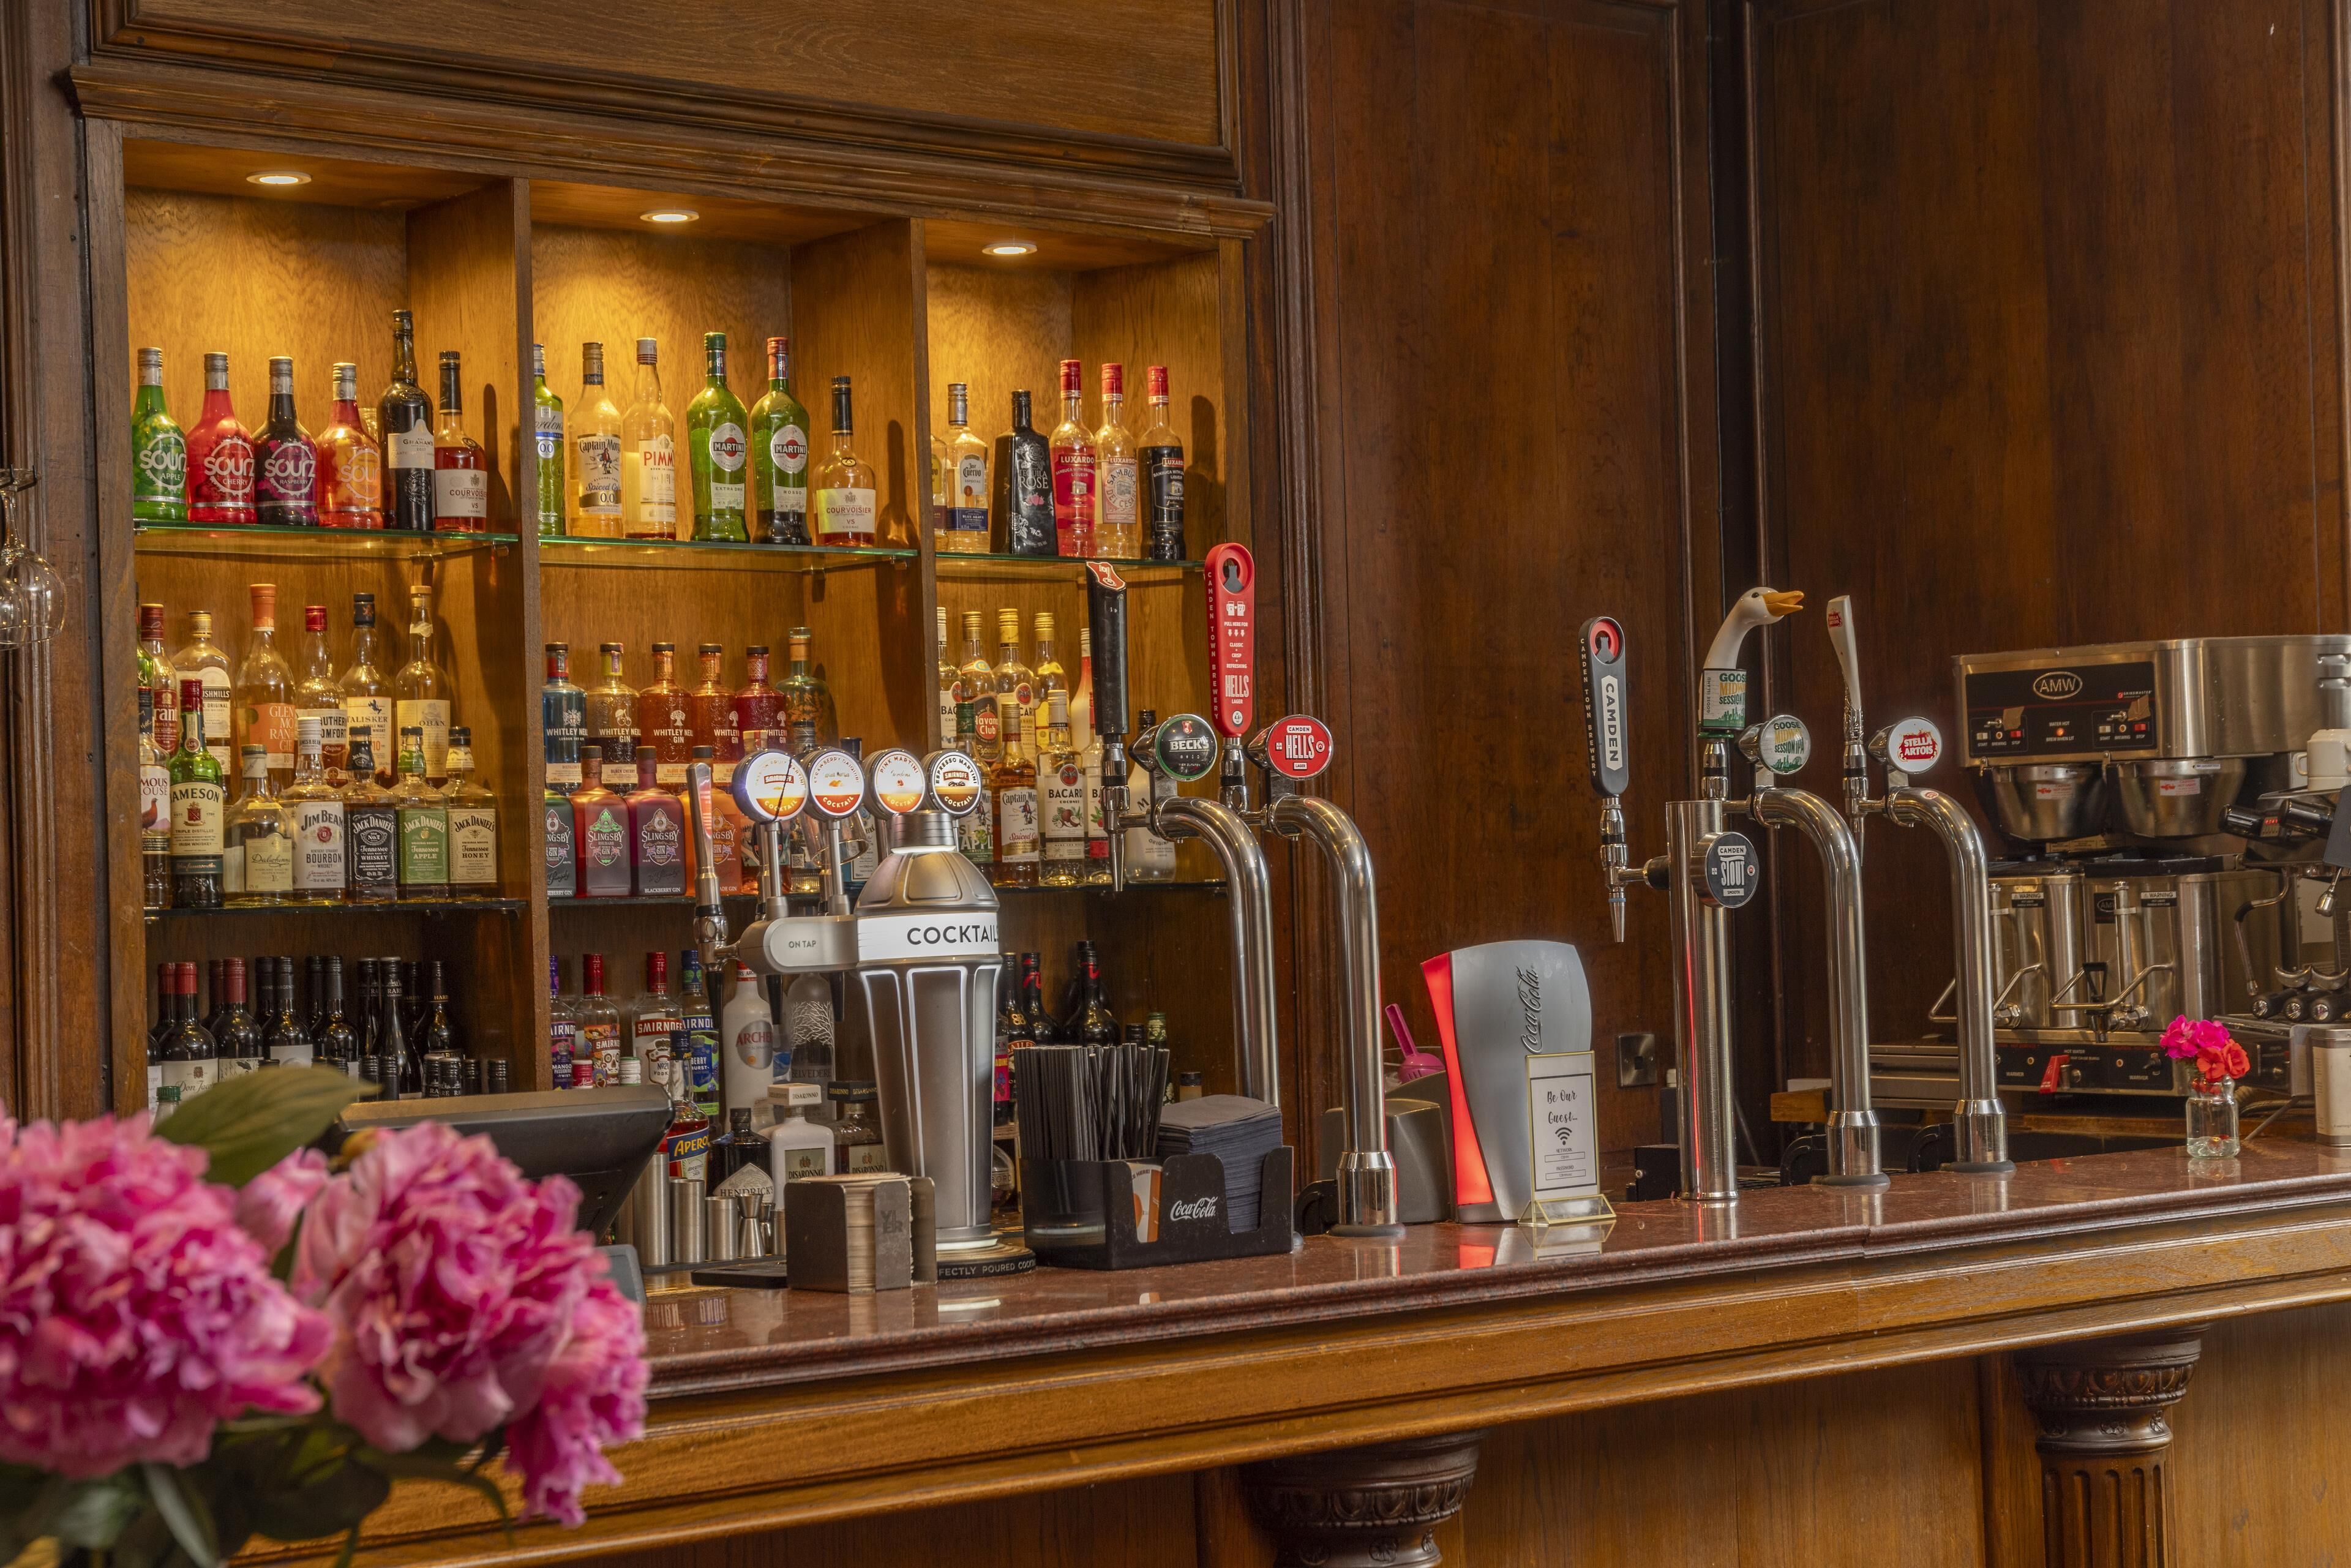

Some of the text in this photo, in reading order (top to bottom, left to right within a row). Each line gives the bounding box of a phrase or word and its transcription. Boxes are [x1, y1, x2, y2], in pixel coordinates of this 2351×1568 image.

[579, 439, 606, 452] Captain
[714, 442, 744, 452] MARTINI
[775, 445, 806, 454] MARTINI
[1060, 456, 1094, 464] LUXARDO
[962, 467, 981, 478] Cuervo
[1019, 477, 1049, 490] ROSE
[1225, 675, 1250, 698] HELLS
[2039, 678, 2076, 693] AMW
[269, 705, 294, 717] GLEN
[1605, 683, 1619, 762] CAMDEN
[1774, 721, 1801, 730] GOOSE
[980, 725, 996, 735] Club
[280, 740, 292, 751] GIE
[1285, 735, 1315, 759] HELLS
[1774, 737, 1804, 754] SESSION IPA
[1904, 737, 1933, 748] STELLA
[1904, 746, 1933, 756] ARTOIS
[880, 759, 892, 773] PINK
[894, 756, 918, 774] MARTINI
[936, 757, 977, 784] ESPRESSO MARTINI
[822, 796, 854, 808] COCKTAIL
[887, 795, 917, 807] COCKTAIL
[944, 795, 972, 807] COCKTAIL
[1002, 791, 1026, 805] Captain
[764, 800, 798, 811] COCKTAIL
[301, 814, 320, 831] JIM
[353, 819, 370, 833] JACK
[403, 816, 446, 833] JACK DANIEL'S
[454, 815, 495, 832] JACK DANIEL'S
[588, 830, 624, 842] SLINGSBY
[642, 830, 680, 842] SLINGSBY
[306, 853, 342, 863] BOURBON
[1720, 855, 1745, 886] STOUT
[1516, 965, 1544, 1054] Coca-Cola
[1547, 1089, 1577, 1105] Be Our
[789, 1168, 823, 1179] DISARONNO
[1170, 1196, 1218, 1221] Coca-Cola
[983, 1263, 1014, 1274] POURED
